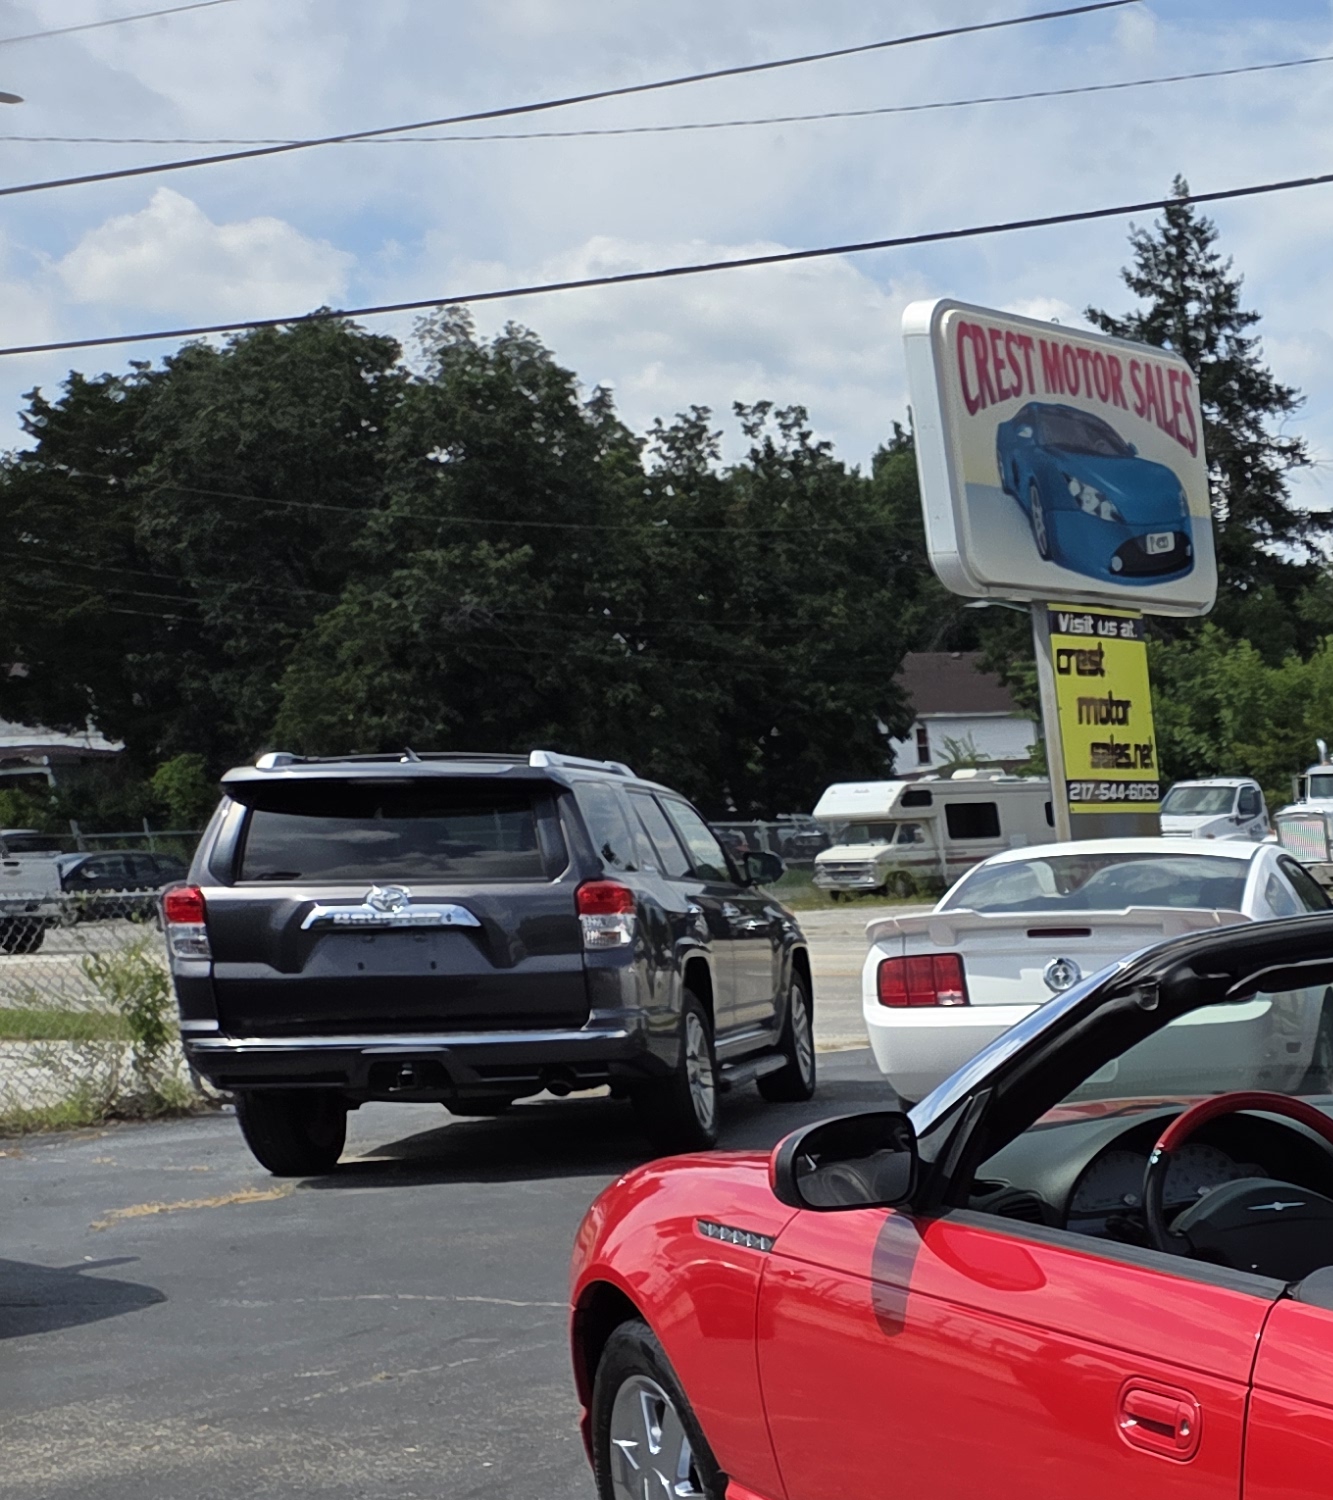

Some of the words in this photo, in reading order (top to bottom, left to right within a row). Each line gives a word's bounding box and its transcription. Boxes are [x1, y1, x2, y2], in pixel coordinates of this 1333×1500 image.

[957, 321, 1036, 416] CREST
[1039, 339, 1129, 411] MOTOR
[1129, 359, 1198, 459] SALES
[1058, 612, 1094, 634] Visit
[1097, 619, 1117, 636] us
[1077, 689, 1132, 726] motor
